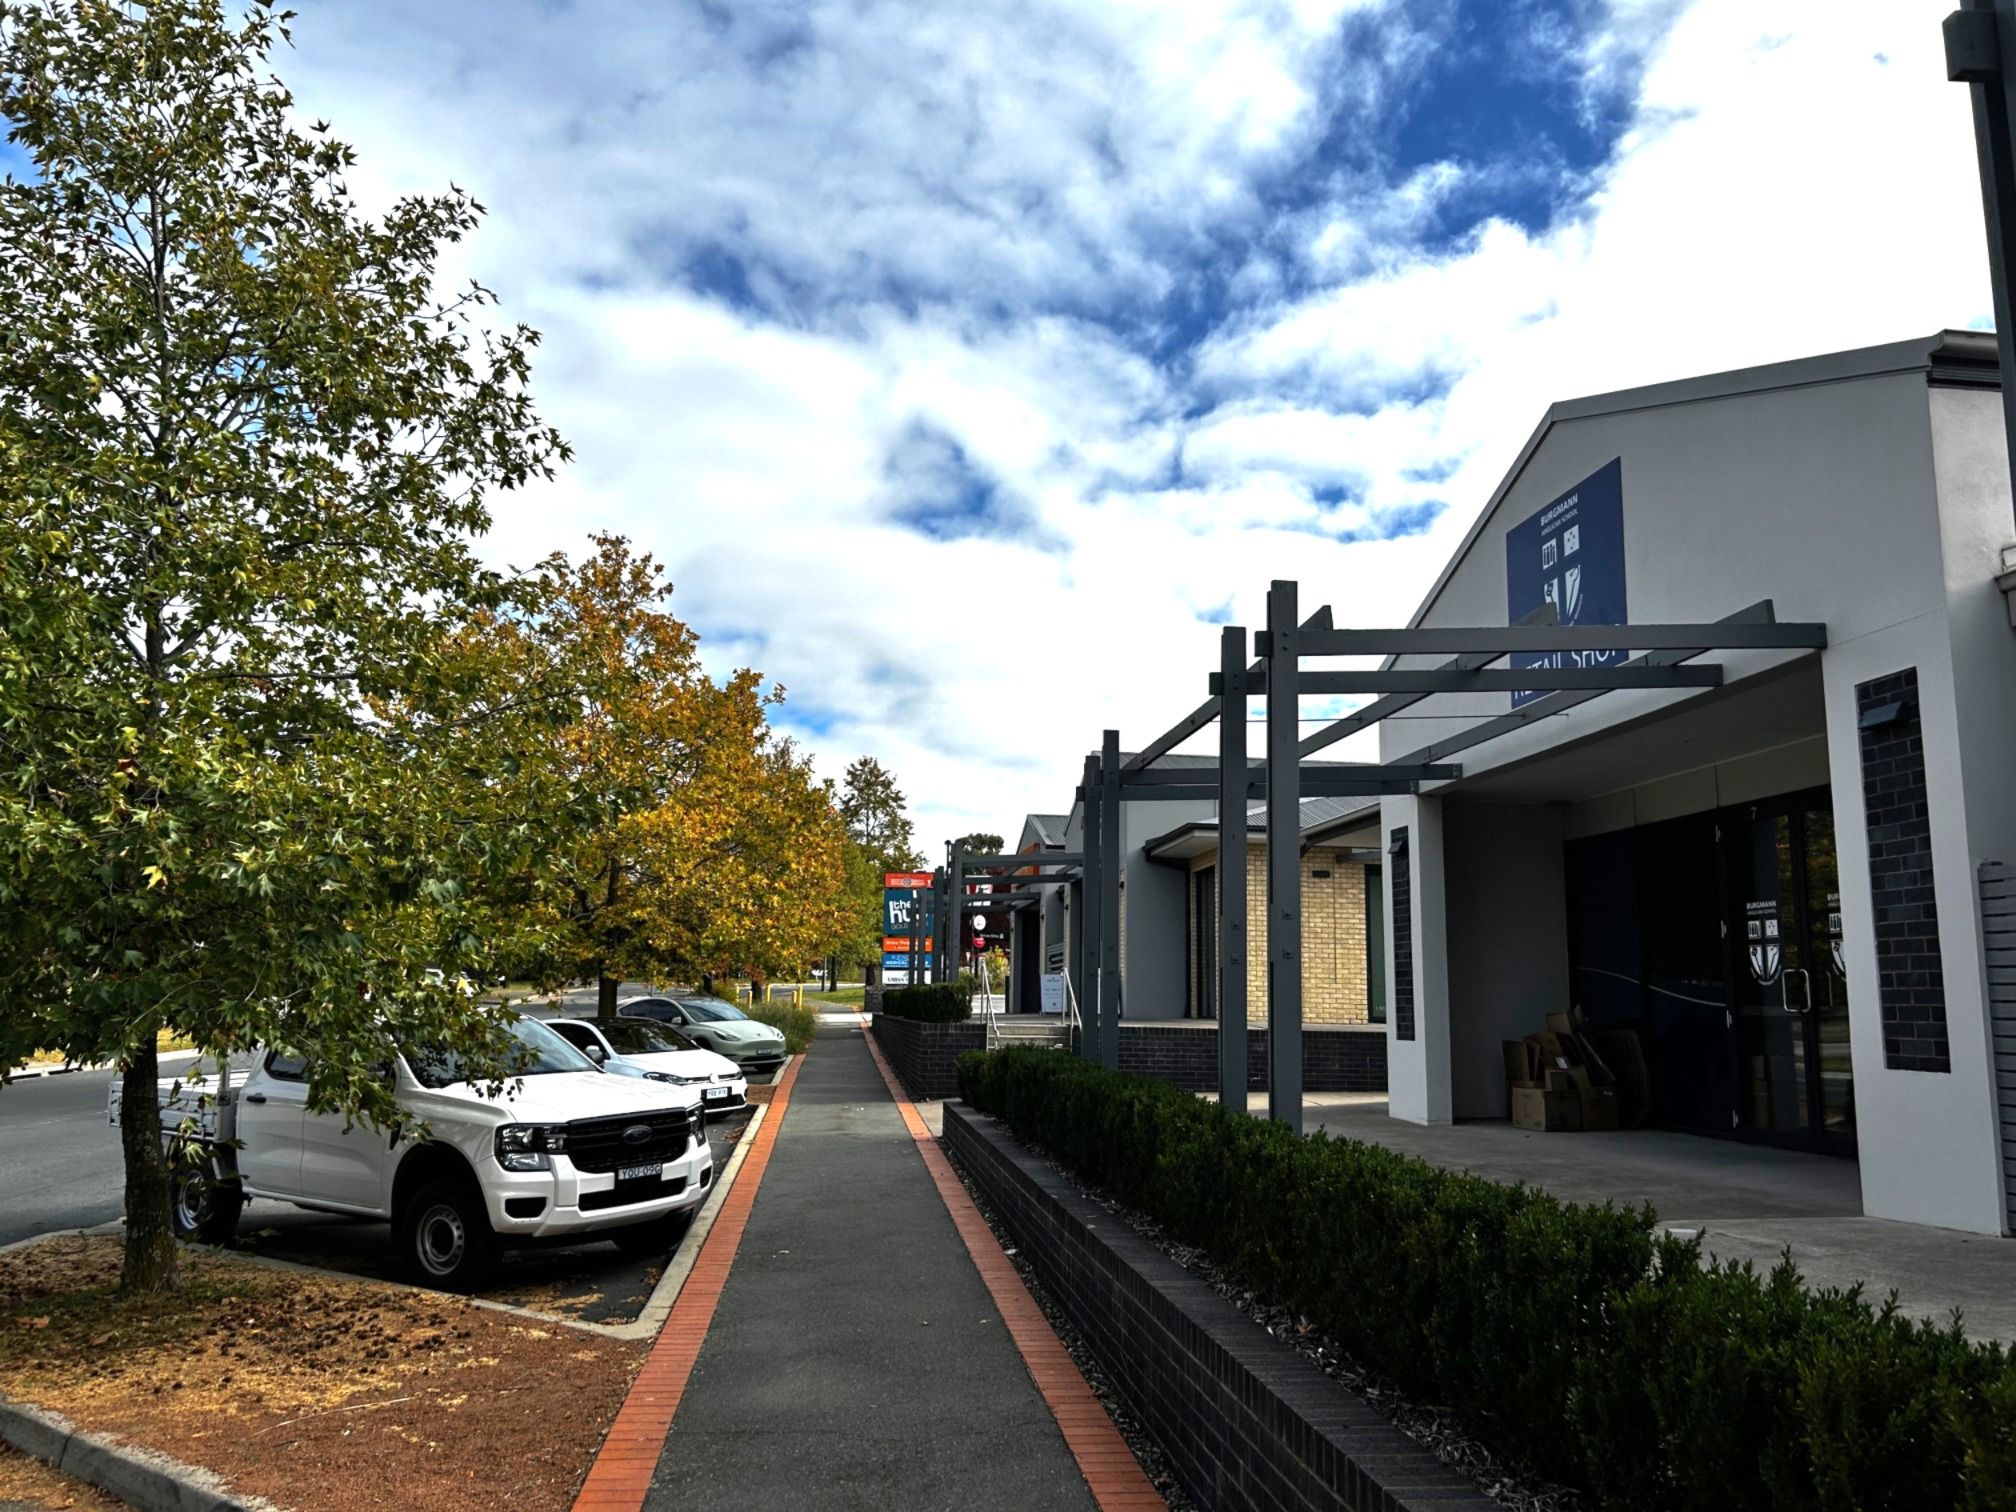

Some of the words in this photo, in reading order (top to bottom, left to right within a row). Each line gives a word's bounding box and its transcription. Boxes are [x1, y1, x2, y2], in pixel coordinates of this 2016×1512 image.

[1541, 492, 1578, 527] BURGMANN
[1561, 507, 1579, 522] SCHOOL
[1746, 901, 1776, 909] BURGMANN
